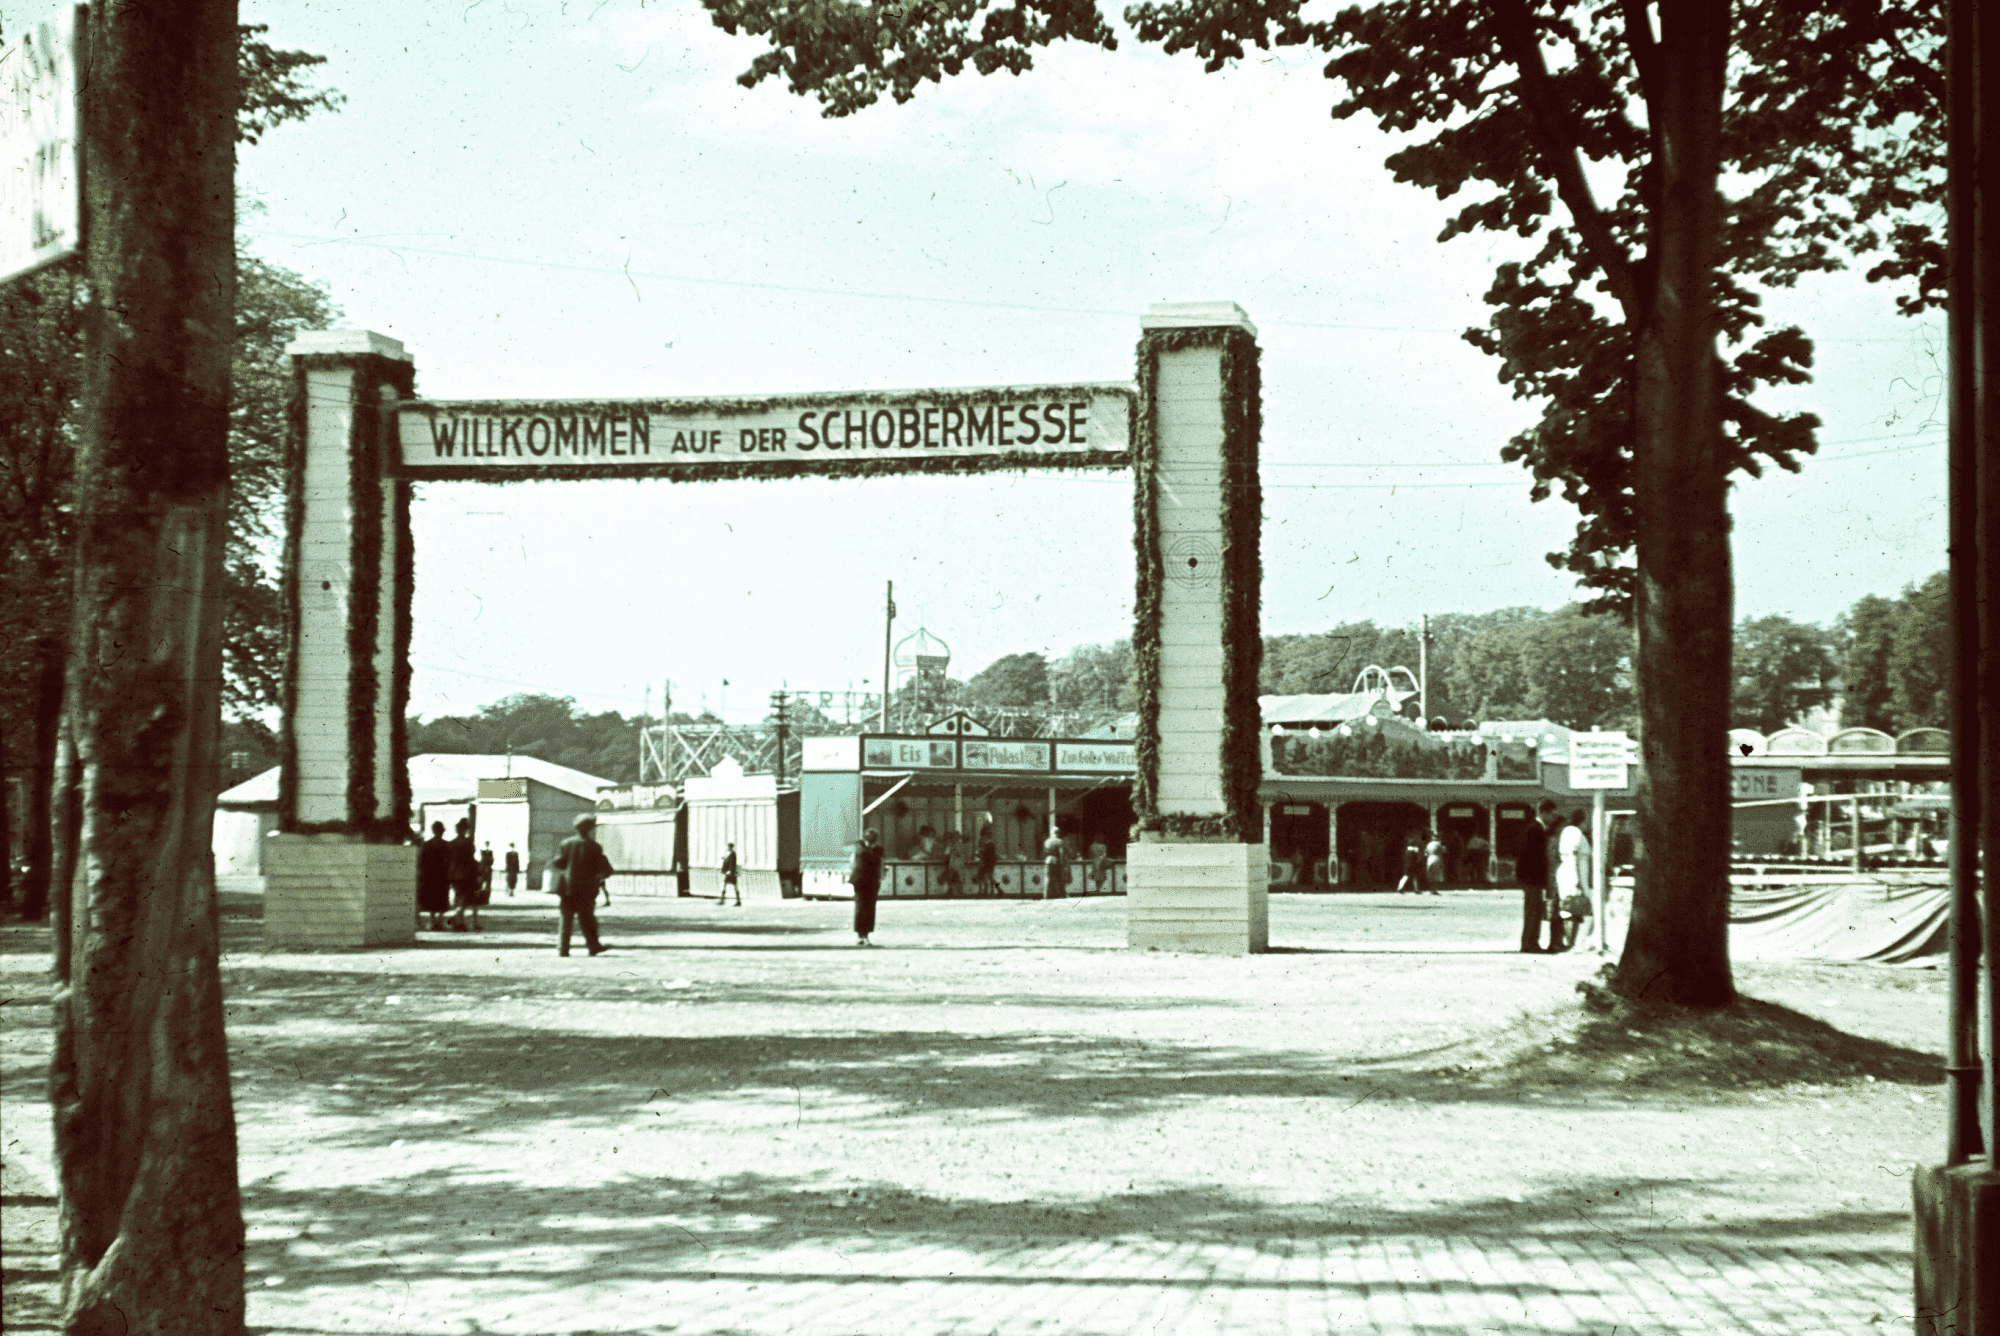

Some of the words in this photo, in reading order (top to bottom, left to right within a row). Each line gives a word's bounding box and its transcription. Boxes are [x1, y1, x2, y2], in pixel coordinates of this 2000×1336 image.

[429, 414, 650, 457] WILLKOMMEN
[671, 430, 721, 453] AUF
[739, 428, 787, 452] DER
[796, 402, 1087, 450] SCHOBERMESSE
